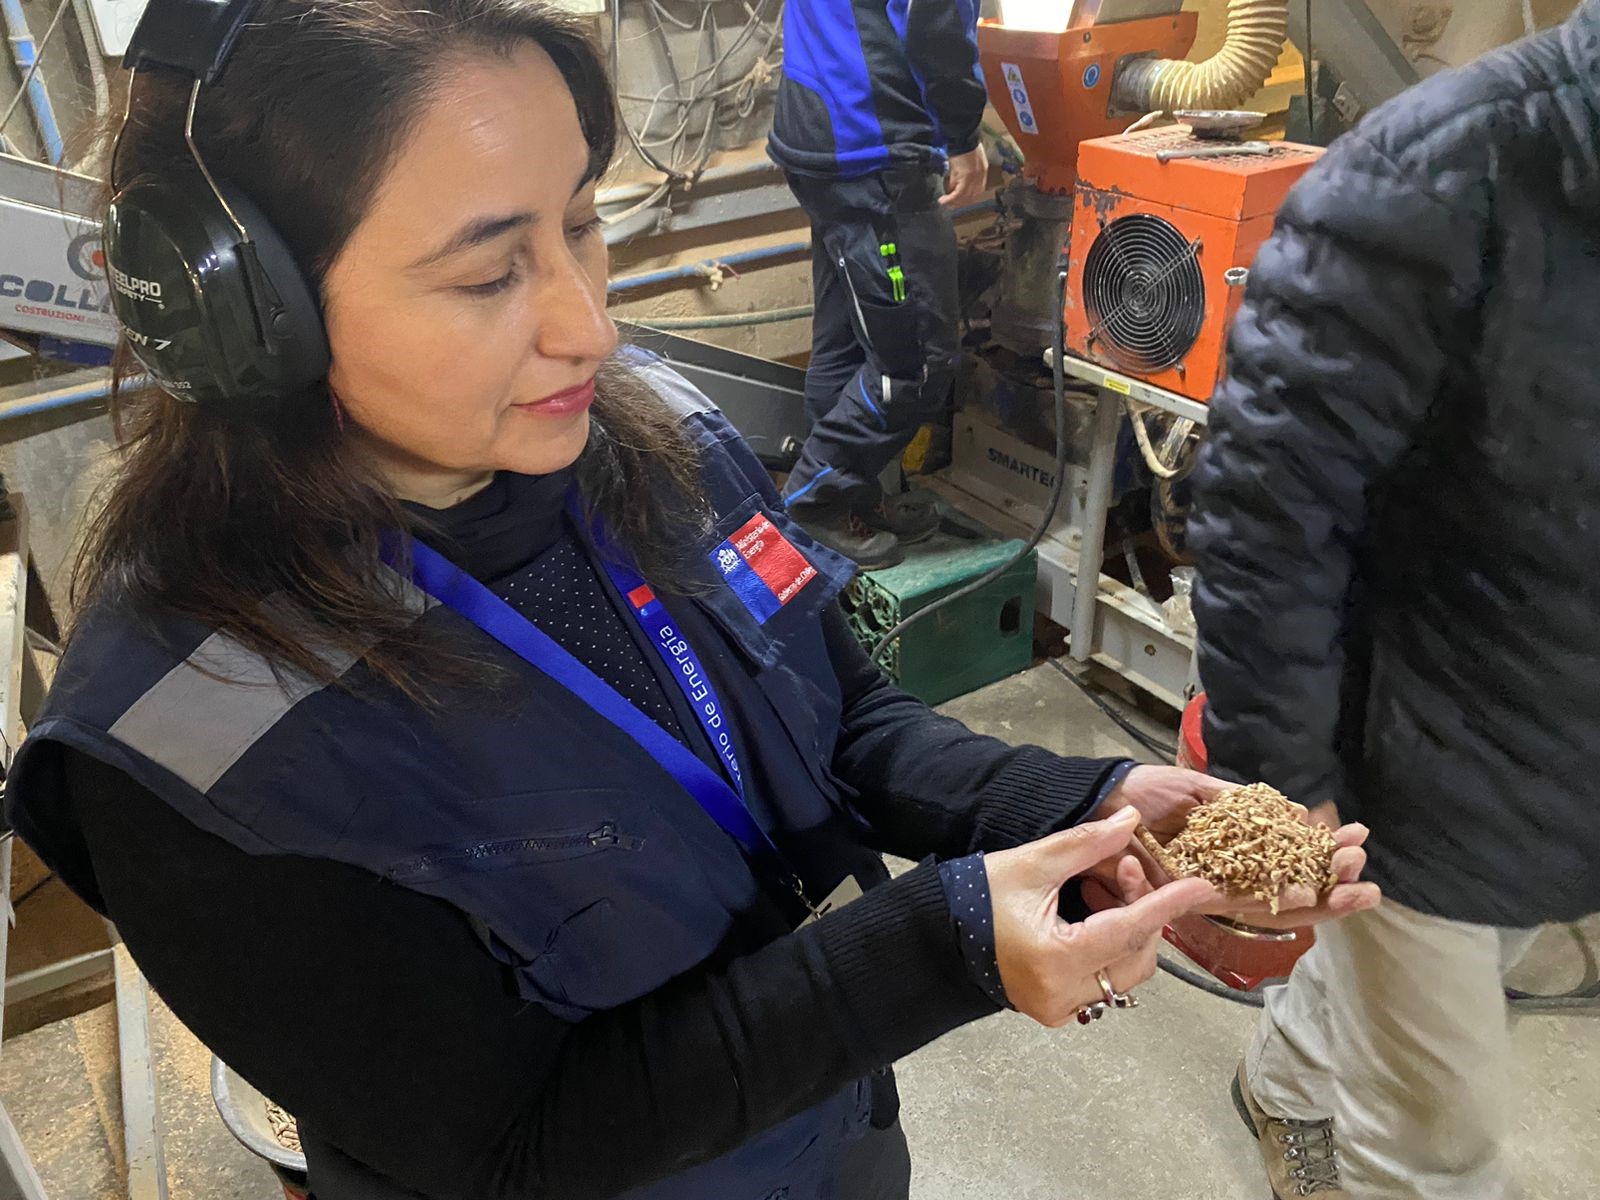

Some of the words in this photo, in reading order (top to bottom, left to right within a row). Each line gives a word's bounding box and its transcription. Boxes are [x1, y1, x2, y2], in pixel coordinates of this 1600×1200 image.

[15, 304, 85, 322] COSTRUZIONI
[154, 338, 172, 351] 7
[659, 625, 708, 702] Energía
[704, 702, 722, 728] de
